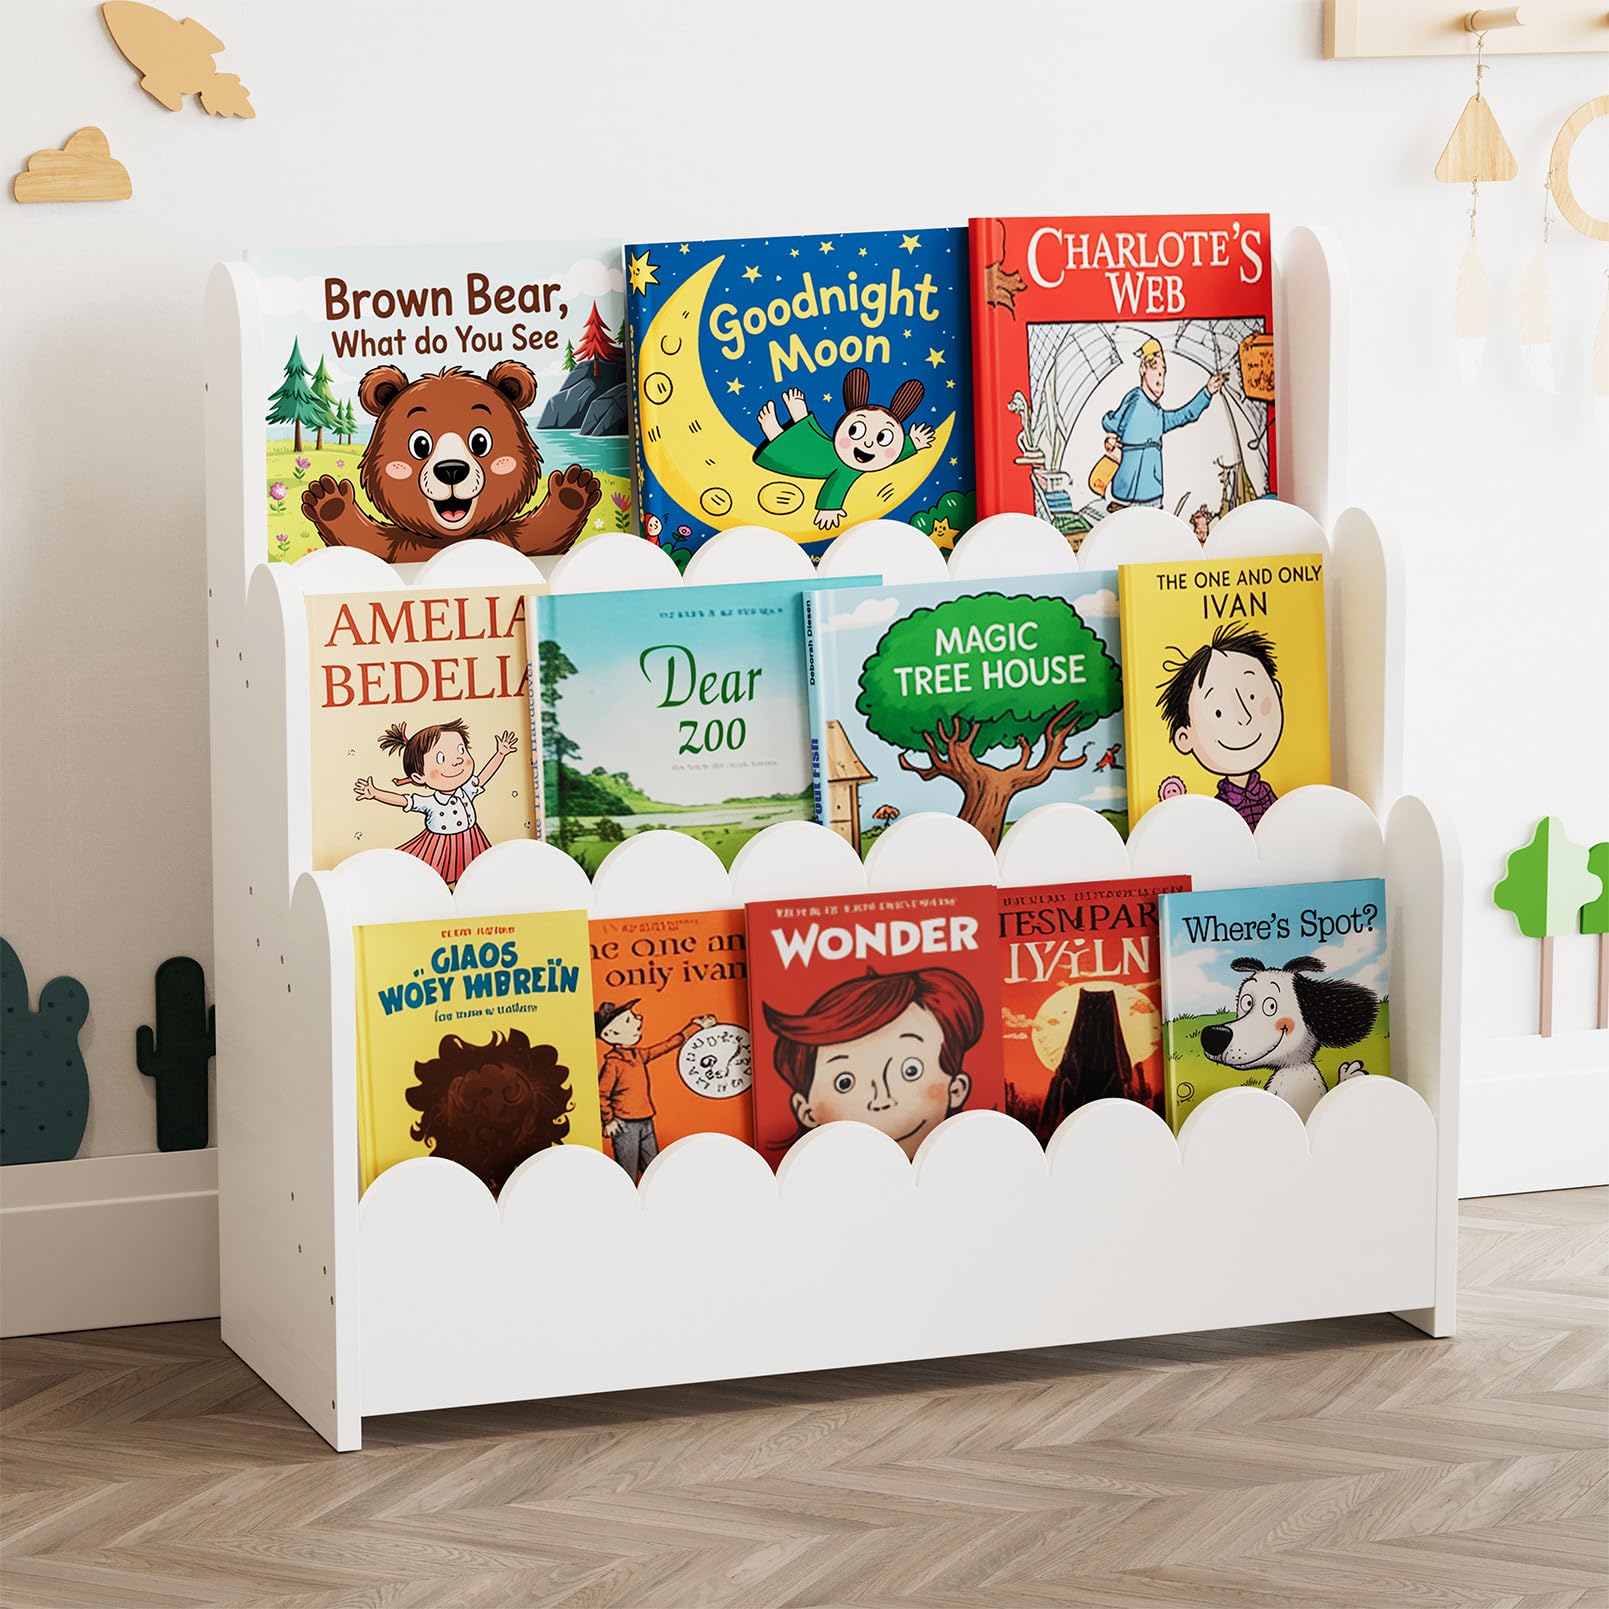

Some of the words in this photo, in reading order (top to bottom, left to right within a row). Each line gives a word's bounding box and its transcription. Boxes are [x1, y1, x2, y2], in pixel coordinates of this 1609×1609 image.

[324, 277, 453, 320] Brown
[466, 272, 569, 319] Bear,
[1105, 271, 1186, 314] WEB
[709, 268, 940, 360] Goodnight
[331, 328, 406, 358] What
[414, 326, 448, 354] do
[455, 324, 503, 353] You
[511, 323, 559, 351] See
[768, 333, 890, 383] Moon
[1156, 573, 1188, 590] THE
[1194, 571, 1231, 588] ONE
[1236, 568, 1273, 586] AND
[1278, 565, 1322, 583] ONLY
[1203, 592, 1268, 619] IVAN
[935, 621, 1038, 656] MAGIC
[639, 644, 762, 708] Dear
[893, 662, 972, 697] TREE
[982, 654, 1087, 690] HOUSE
[708, 933, 746, 952] an
[771, 916, 979, 970] WONDER
[1182, 912, 1290, 944] Where's
[1300, 904, 1379, 942] Spot?
[683, 960, 747, 982] ivan
